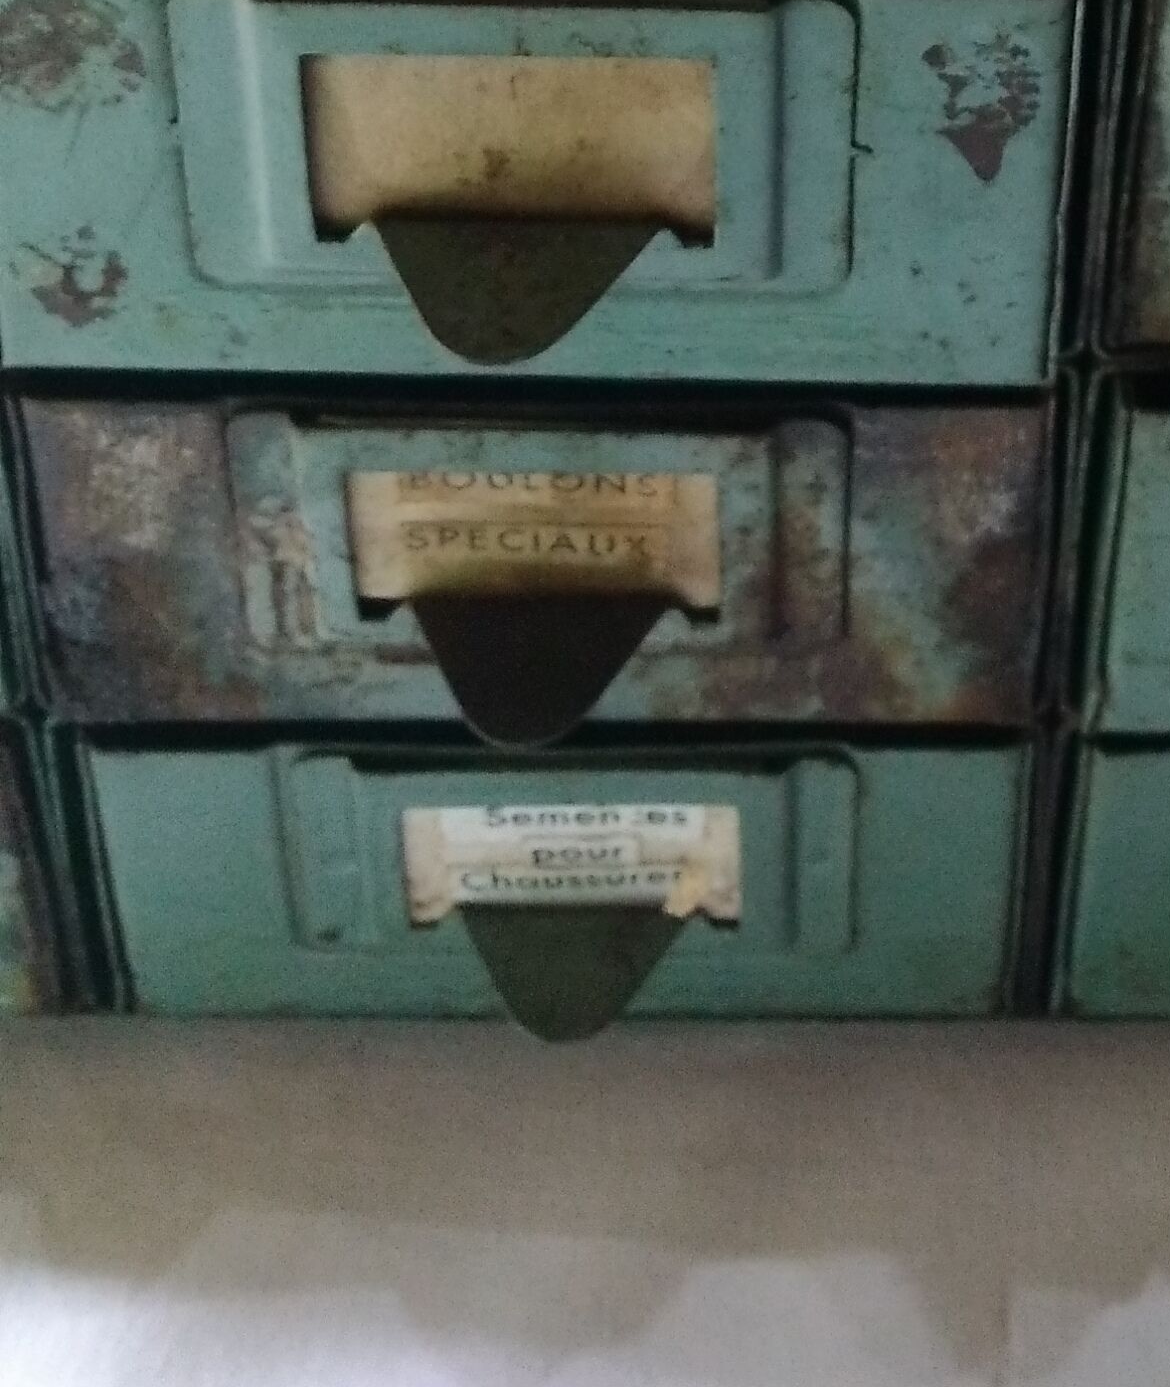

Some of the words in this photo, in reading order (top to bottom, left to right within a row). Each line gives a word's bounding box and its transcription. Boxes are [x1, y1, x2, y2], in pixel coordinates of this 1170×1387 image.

[407, 526, 648, 556] SPECIAUX
[486, 805, 687, 827] Semenes
[532, 847, 622, 868] pour
